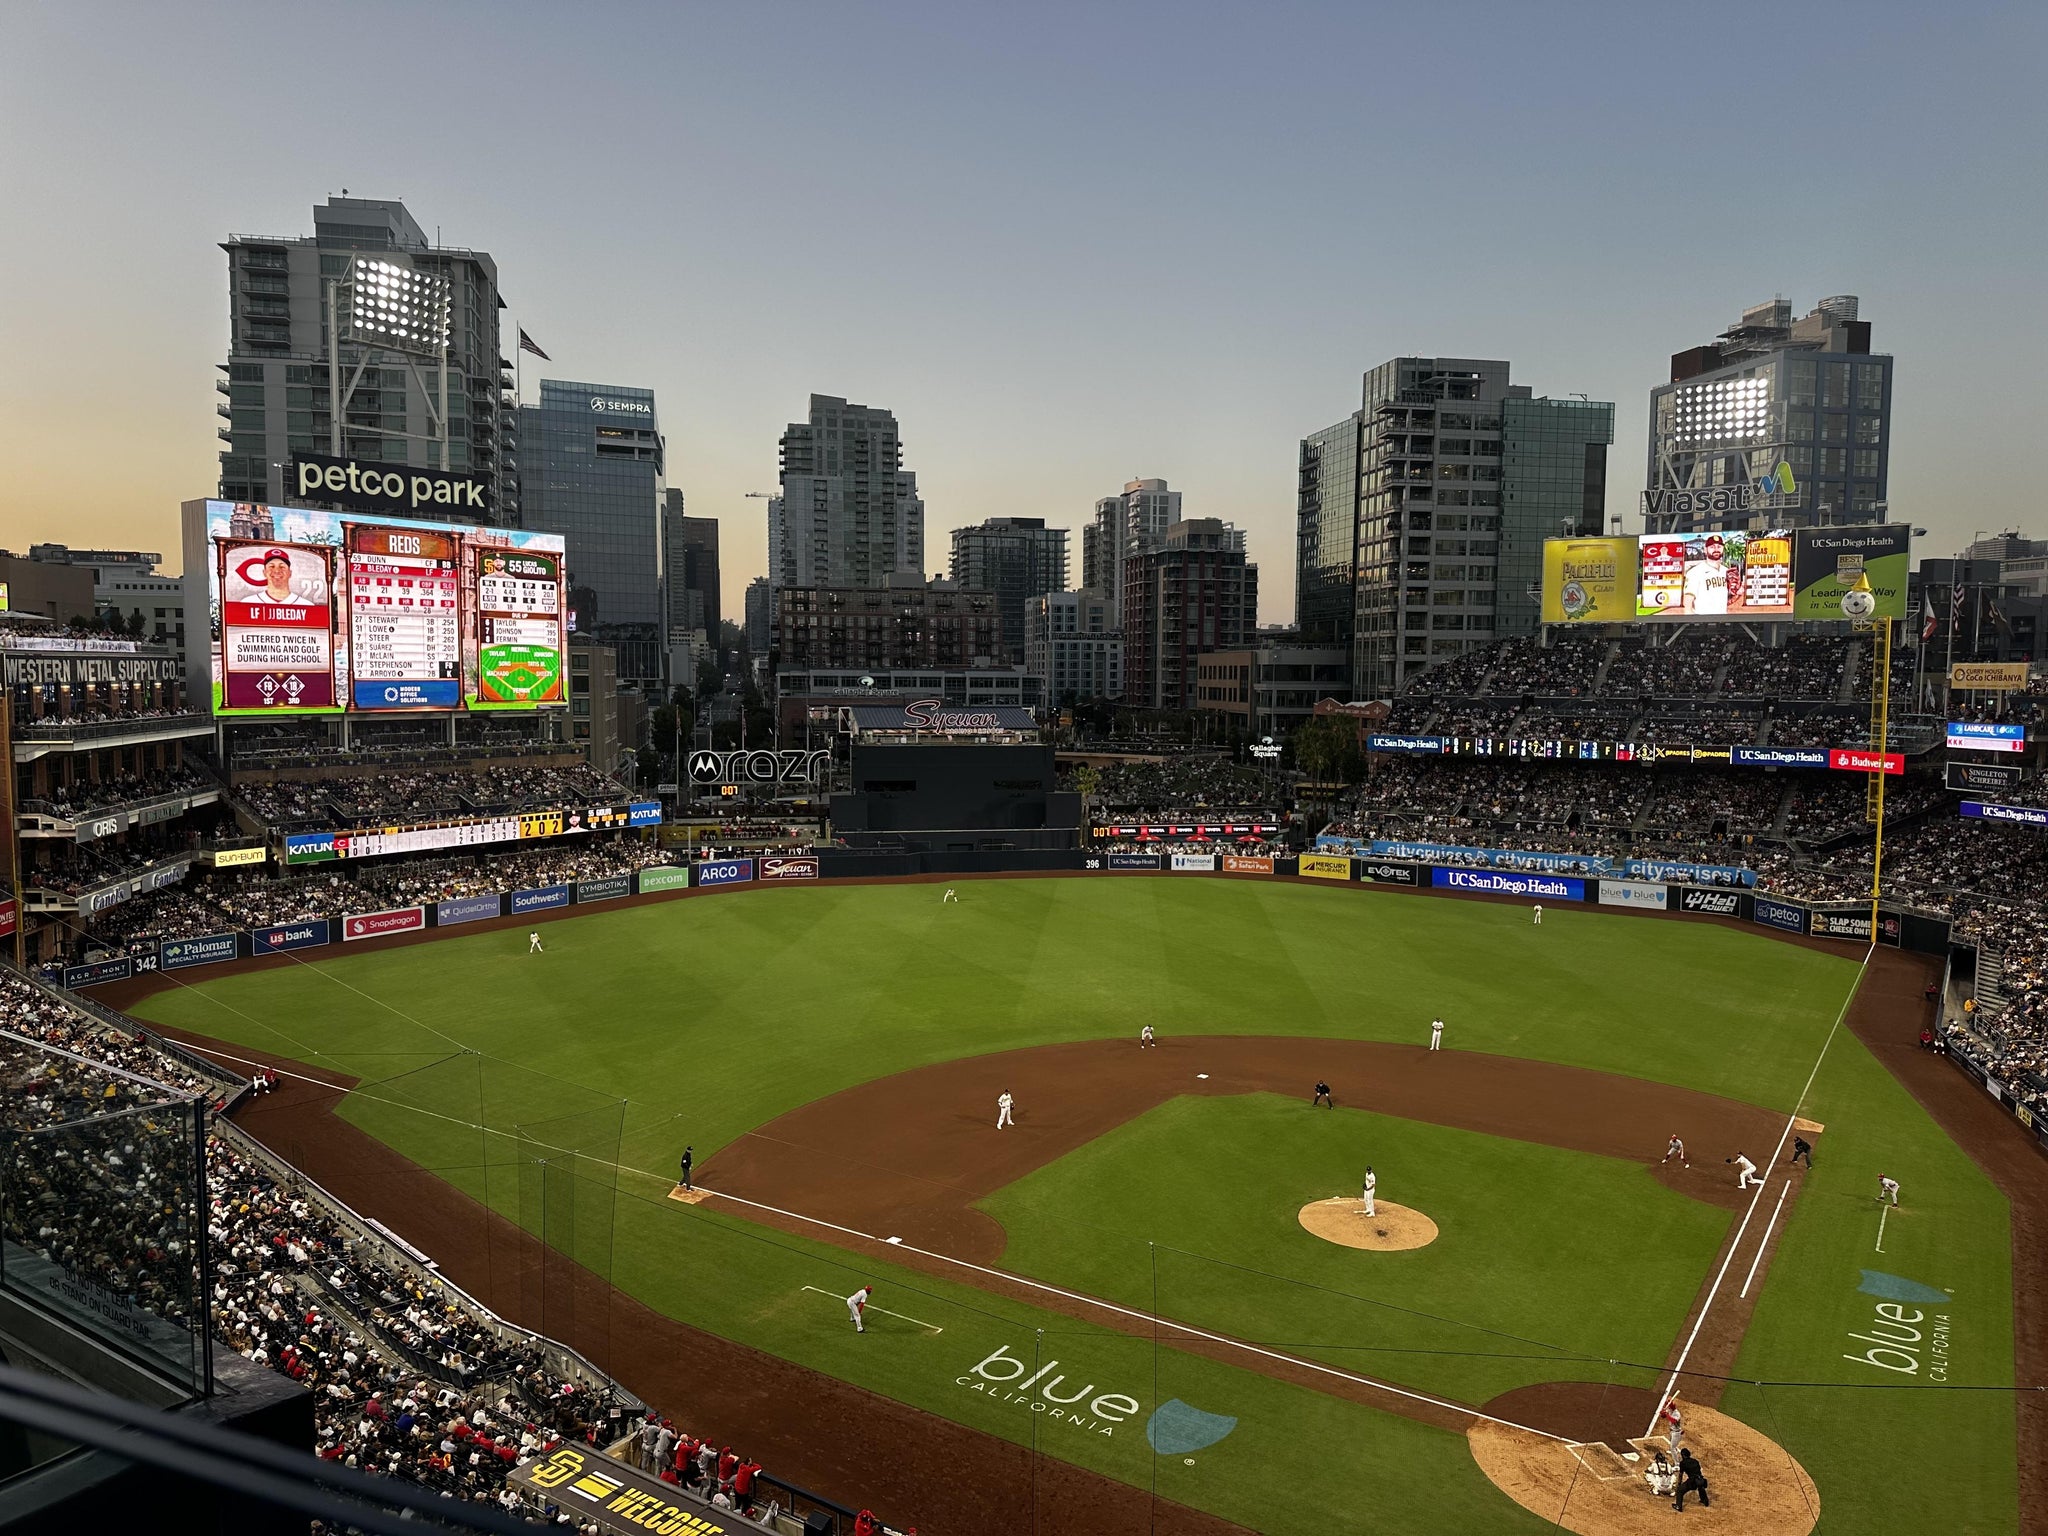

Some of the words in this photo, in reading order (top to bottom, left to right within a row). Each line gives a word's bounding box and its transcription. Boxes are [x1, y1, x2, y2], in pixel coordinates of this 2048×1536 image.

[608, 402, 651, 413] SEMPRA
[299, 462, 404, 497] petco
[412, 477, 485, 508] park
[1644, 485, 1749, 515] Viasat
[389, 534, 421, 555] REDS
[1811, 539, 1825, 548] UC
[1825, 538, 1841, 547] San
[1842, 538, 1866, 548] Diego
[1866, 537, 1894, 546] Health
[367, 556, 386, 564] DUNN
[1838, 555, 1861, 563] BEST
[367, 565, 392, 573] BLEDAY
[509, 559, 522, 573] 55
[1562, 561, 1616, 581] PACIFICO
[300, 579, 324, 602] 22
[441, 590, 454, 598] .567
[1874, 588, 1897, 598] Way
[1810, 601, 1819, 609] in
[1822, 601, 1840, 609] San
[250, 607, 260, 619] LF
[276, 608, 306, 621] BLEDAY
[241, 634, 281, 644] LETTERED
[283, 635, 306, 644] TWICE
[308, 636, 316, 644] IN
[369, 634, 390, 642] STEER
[237, 644, 281, 653] SWIMMING
[282, 645, 300, 653] AND
[301, 645, 321, 654] GOLF
[369, 643, 392, 651] SUÁREZ
[237, 654, 268, 663] DURING
[270, 655, 289, 663] HIGH
[291, 655, 322, 663] SCHOOL
[370, 652, 394, 660] McLAIN
[6, 659, 71, 683] WESTERN
[77, 659, 116, 682] METAL
[118, 660, 158, 681] SUPPLY
[162, 660, 179, 680] CO.
[370, 661, 412, 669] STEPHENSON
[1965, 674, 1983, 682] CoCo
[1984, 674, 2023, 682] ICHIBANYA
[263, 697, 274, 705] 1ST
[903, 699, 1001, 735] Sycuan
[1964, 725, 1995, 736] LANDCARE
[1996, 726, 2017, 734] LOGIC
[1249, 744, 1283, 753] Gallagher
[1374, 738, 1385, 747] UC
[1384, 739, 1398, 747] San
[1398, 740, 1416, 749] Diego
[1416, 740, 1438, 749] Health
[1740, 750, 1754, 760] UC
[1754, 751, 1771, 761] San
[1771, 752, 1796, 763] Diego
[1796, 752, 1824, 763] Health
[725, 750, 830, 784] razr
[1968, 768, 2008, 779] SINGLETON
[721, 785, 739, 796] 0:07
[631, 808, 660, 819] KATUN
[1982, 806, 1993, 816] UC
[1993, 807, 2005, 817] San
[2005, 809, 2024, 821] Diego
[2024, 812, 2047, 823] Health
[95, 818, 118, 838] ORIS
[525, 823, 532, 837] 2
[539, 821, 545, 835] 0
[552, 820, 559, 833] 2
[288, 842, 334, 855] KATUN
[764, 859, 813, 877] Sycuan
[1085, 859, 1099, 869] 396
[1120, 858, 1129, 866] San
[1130, 858, 1142, 866] Diego
[1238, 862, 1256, 870] Safari
[1315, 861, 1347, 869] MERCURY
[701, 866, 738, 881] ARCO
[1315, 866, 1347, 874] INSURANCE
[1367, 865, 1411, 878] EVOTEK
[644, 873, 683, 887] dexcom
[1448, 872, 1468, 887] UC
[1468, 873, 1492, 889] San
[1492, 876, 1527, 894] Diego
[1527, 879, 1568, 896] Health
[579, 880, 628, 894] CYMBIOTIKA
[1601, 887, 1622, 897] blue
[515, 894, 559, 907] Southwest
[1634, 889, 1656, 899] blue
[1702, 893, 1738, 906] H2O
[452, 901, 498, 916] QuidelOrtho
[1699, 904, 1734, 913] POWER
[1769, 906, 1800, 923] petco
[24, 916, 38, 932] 330
[369, 914, 416, 930] Snapdragon
[1829, 917, 1849, 926] SLAP
[270, 933, 284, 944] us
[285, 928, 314, 942] bank
[1829, 924, 1853, 934] CHEESE
[1853, 926, 1863, 935] ON
[183, 940, 233, 955] Palomar
[168, 953, 200, 964] SPECIALTY
[200, 948, 233, 960] INSURANCE
[136, 956, 157, 972] 342
[78, 1274, 94, 1291] NOT
[96, 1284, 107, 1299] SIT
[111, 1289, 133, 1313] LEAN
[50, 1276, 60, 1291] OR
[62, 1282, 87, 1306] STAND
[89, 1297, 101, 1313] ON
[102, 1305, 131, 1329] GUARD
[133, 1320, 152, 1341] RAIL
[1842, 1302, 1924, 1375] blue
[1929, 1314, 1951, 1382] CALIFORNIA
[969, 1344, 1139, 1422] blue
[955, 1376, 1114, 1437] CALIFORNIA
